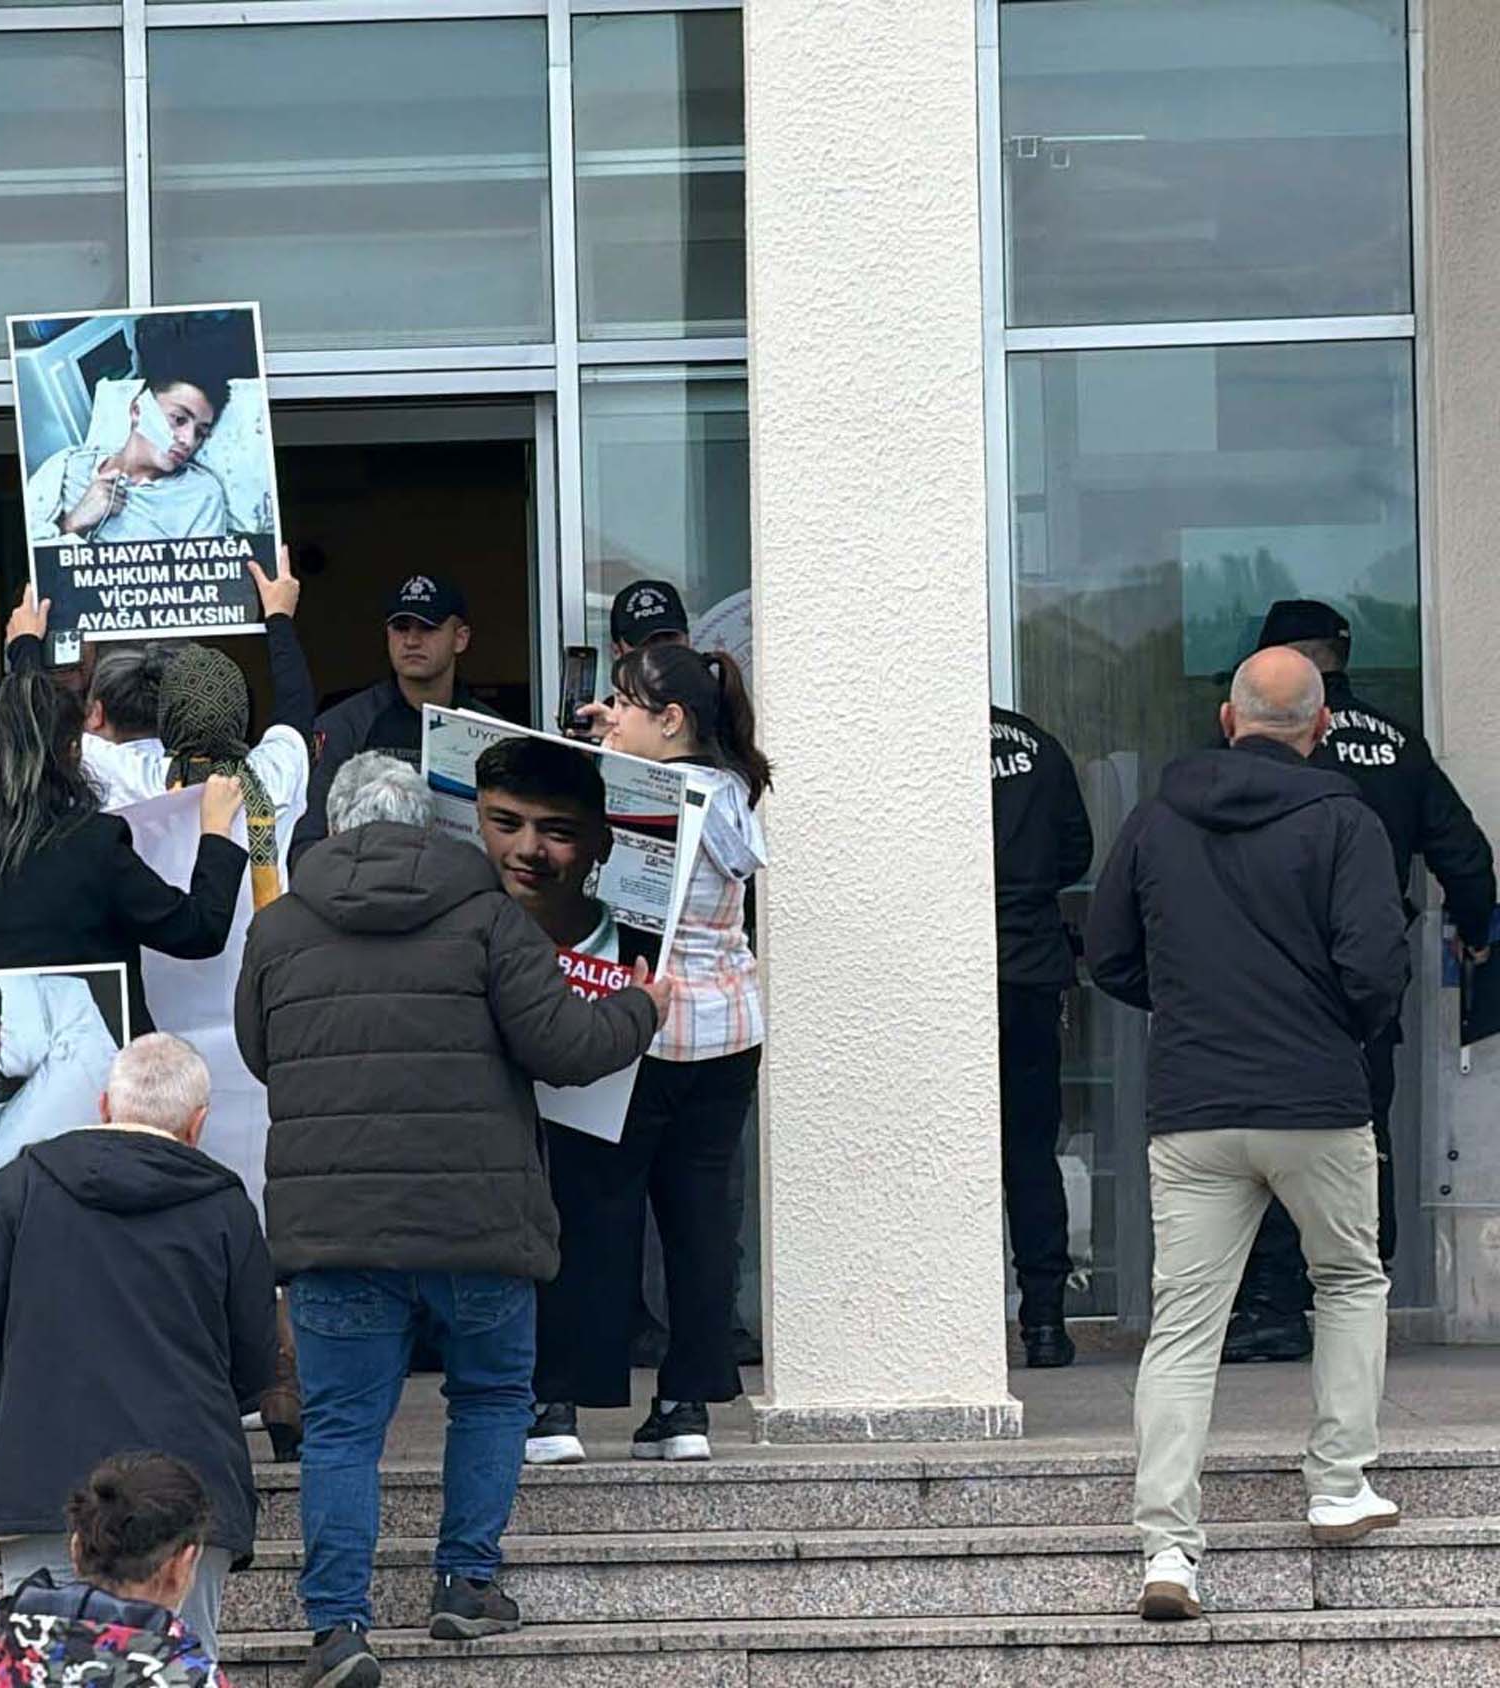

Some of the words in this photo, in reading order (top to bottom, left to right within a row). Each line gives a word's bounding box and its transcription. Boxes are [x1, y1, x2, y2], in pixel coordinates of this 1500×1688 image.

[59, 545, 95, 567] BİR
[98, 543, 167, 563] HAYAT
[170, 537, 254, 559] YATAĞA
[74, 565, 170, 588] MAHKUM
[175, 563, 242, 582] KALDI!
[99, 585, 219, 608] VİCDANLAR
[77, 608, 146, 630] AYAĞA
[150, 606, 246, 625] KALKSIN!
[990, 723, 1038, 755] UVVET
